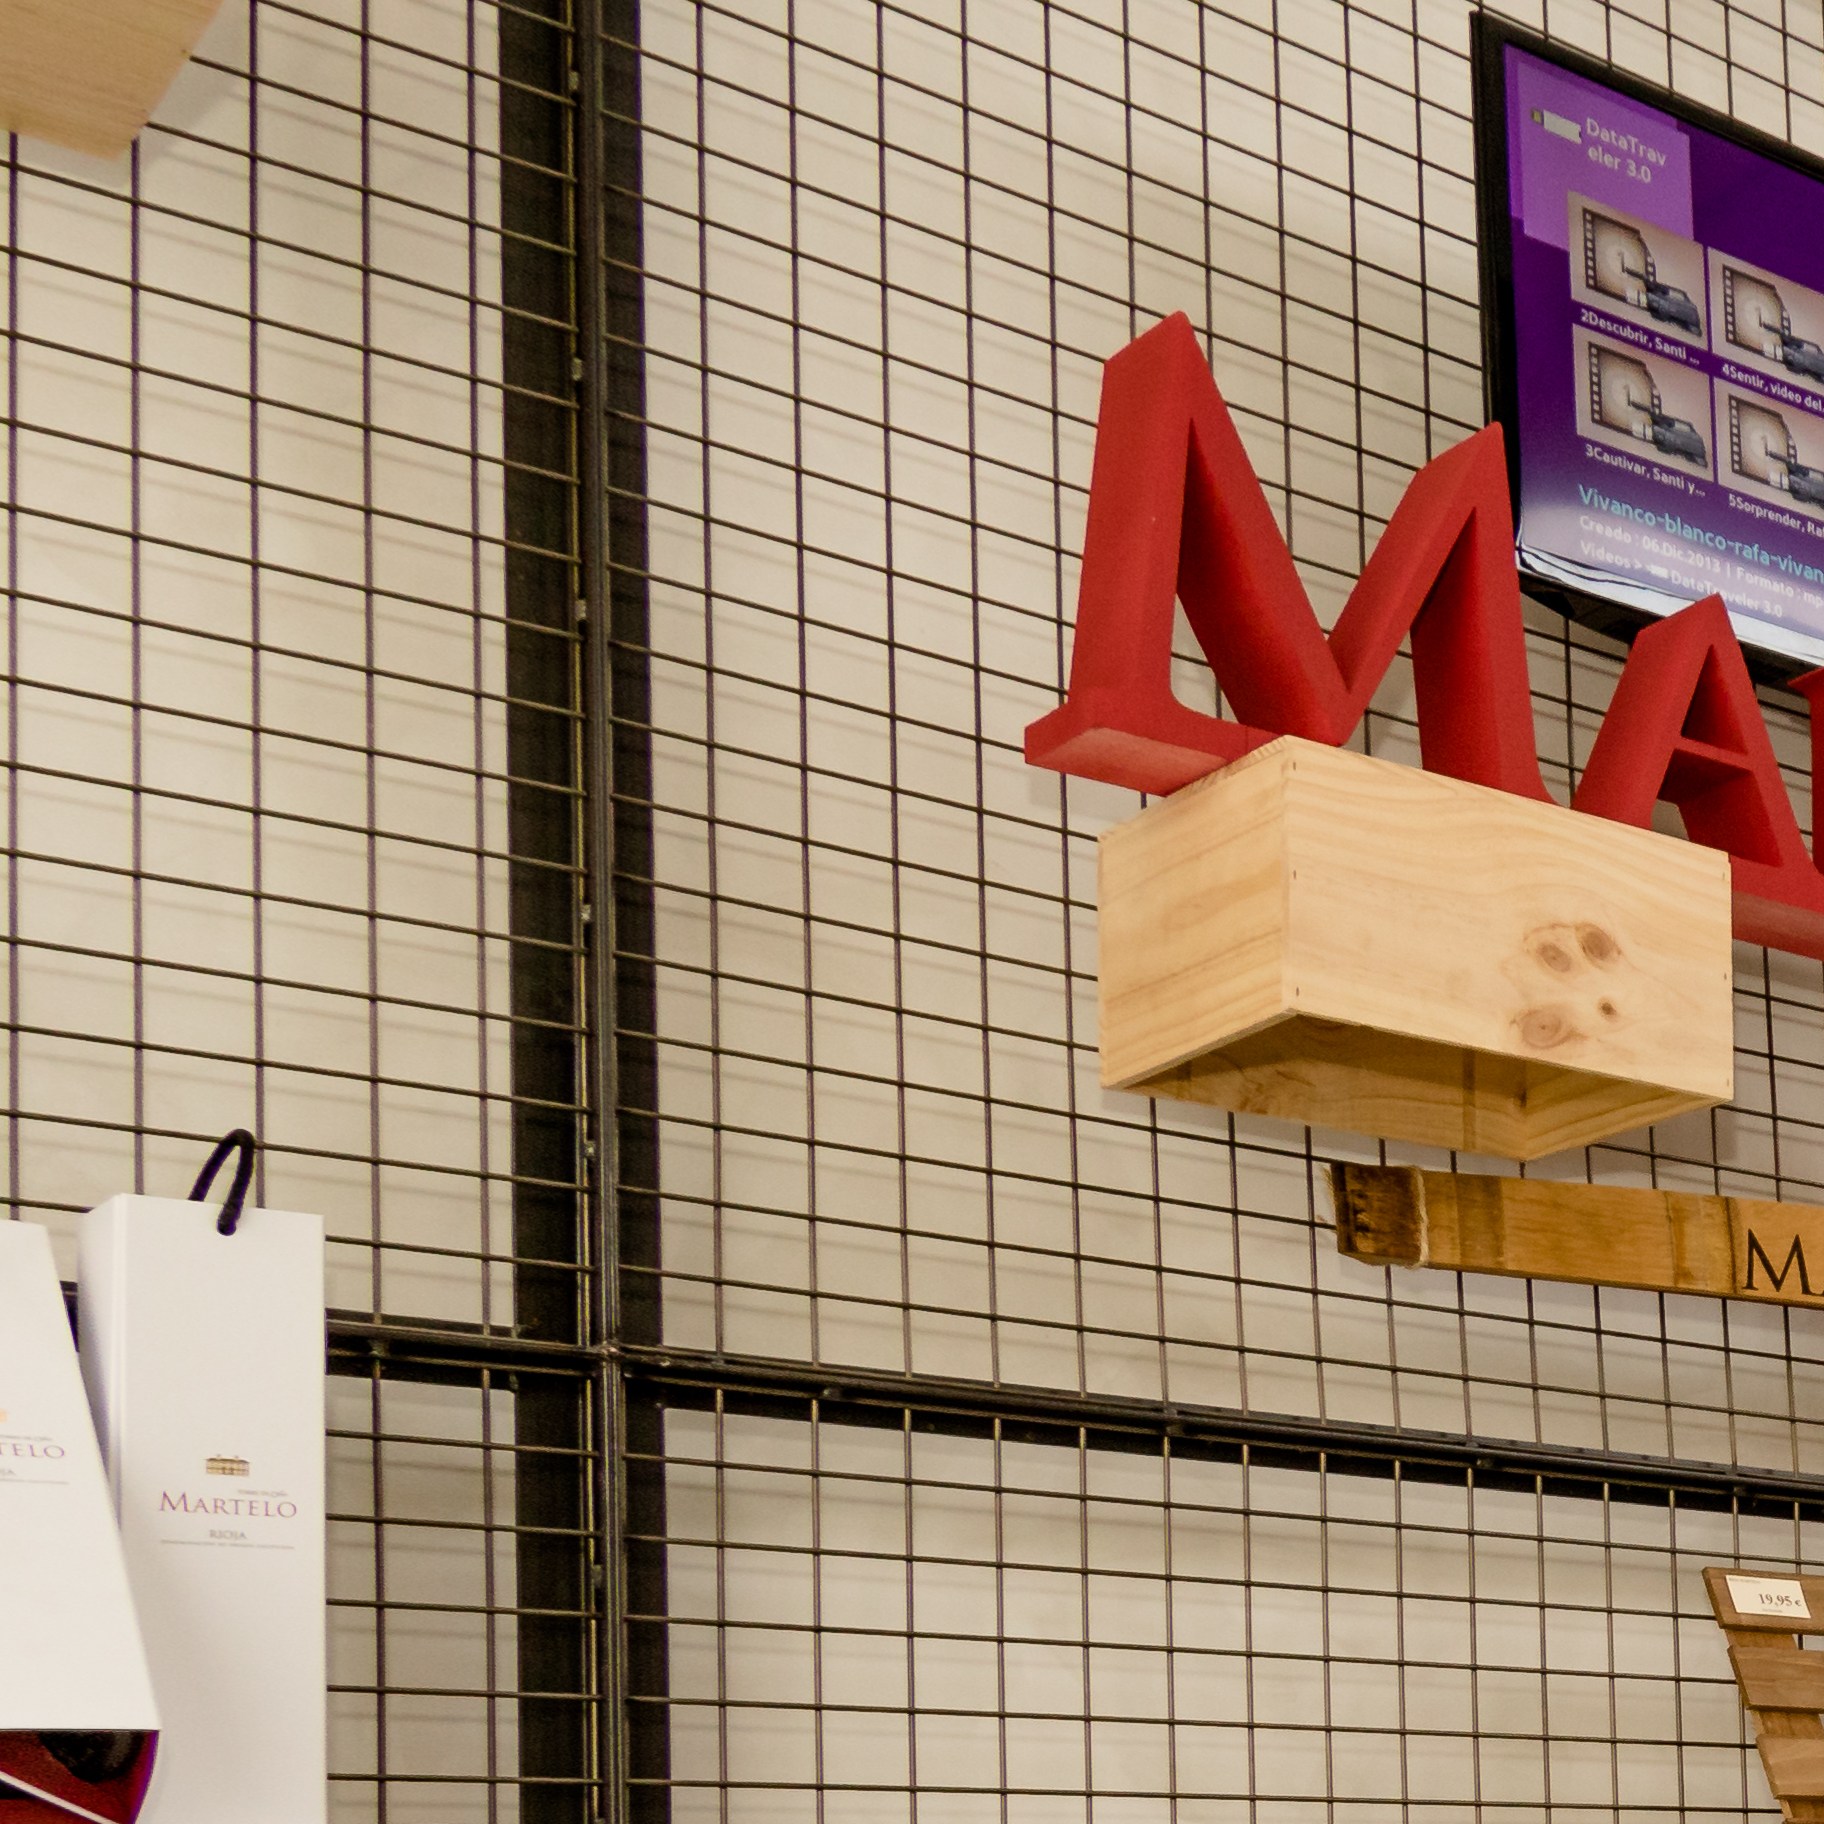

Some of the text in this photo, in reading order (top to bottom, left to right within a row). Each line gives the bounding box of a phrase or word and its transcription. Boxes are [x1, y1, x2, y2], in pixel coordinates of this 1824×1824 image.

[1586, 118, 1667, 167] DataTrav
[1588, 146, 1652, 184] eler 3.0
[1579, 515, 1632, 545] Creado
[1736, 566, 1795, 598] Formato
[158, 1489, 298, 1519] MARTELO
